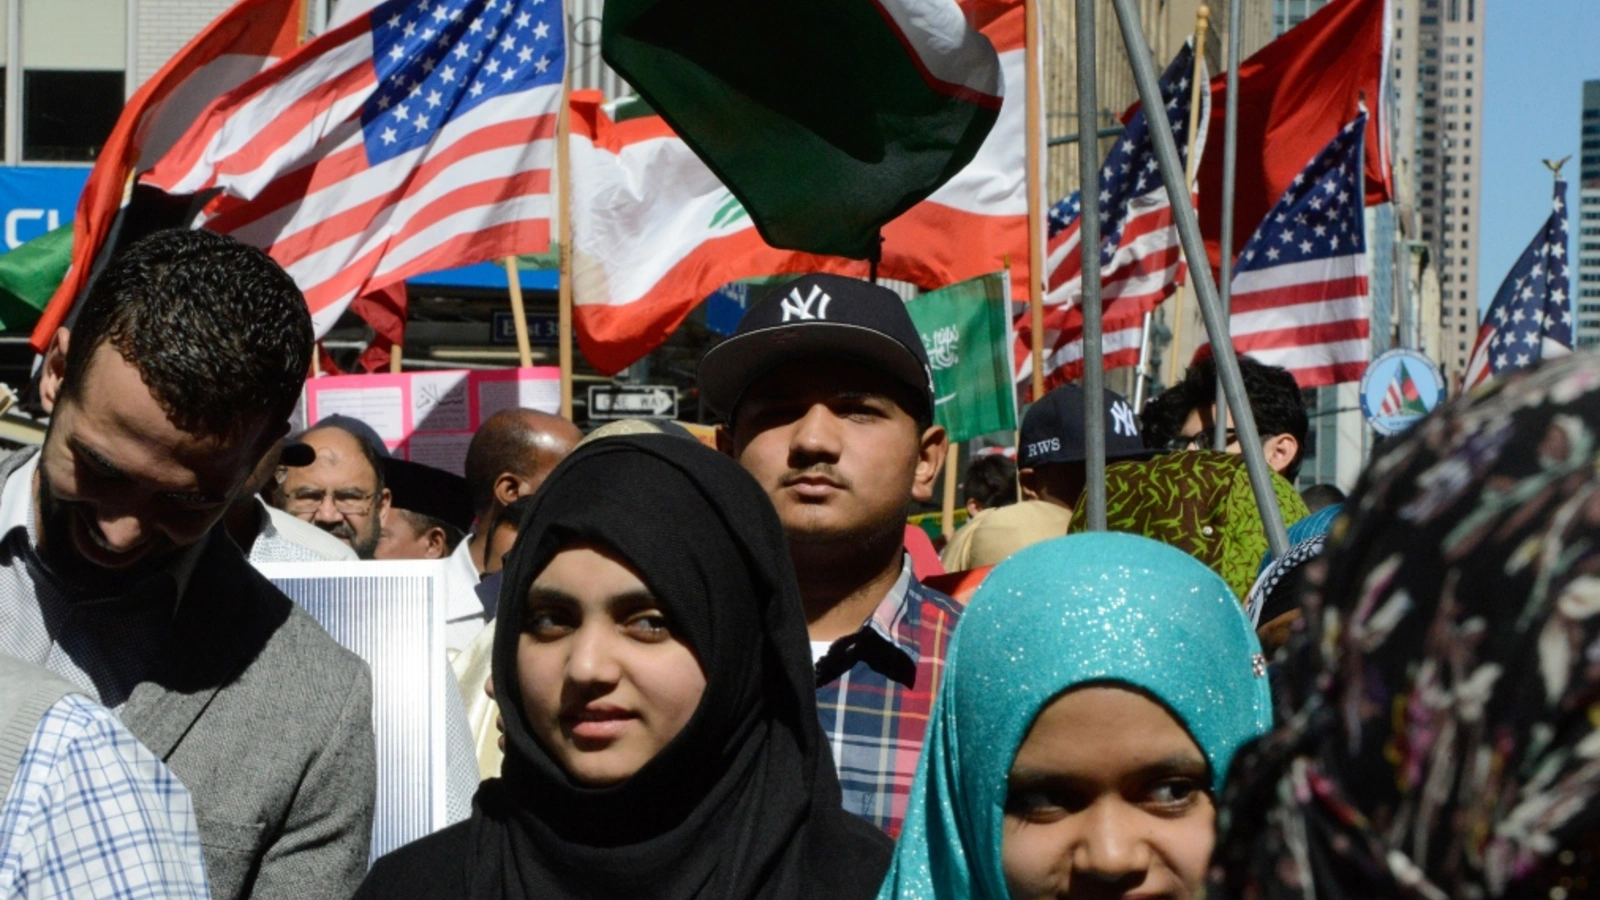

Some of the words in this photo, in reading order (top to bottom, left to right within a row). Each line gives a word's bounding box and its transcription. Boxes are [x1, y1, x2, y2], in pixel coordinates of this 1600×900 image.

[780, 284, 833, 322] NY
[502, 319, 540, 337] Est
[641, 396, 665, 408] WAY
[1110, 400, 1138, 437] NY
[1027, 437, 1061, 458] RWS
